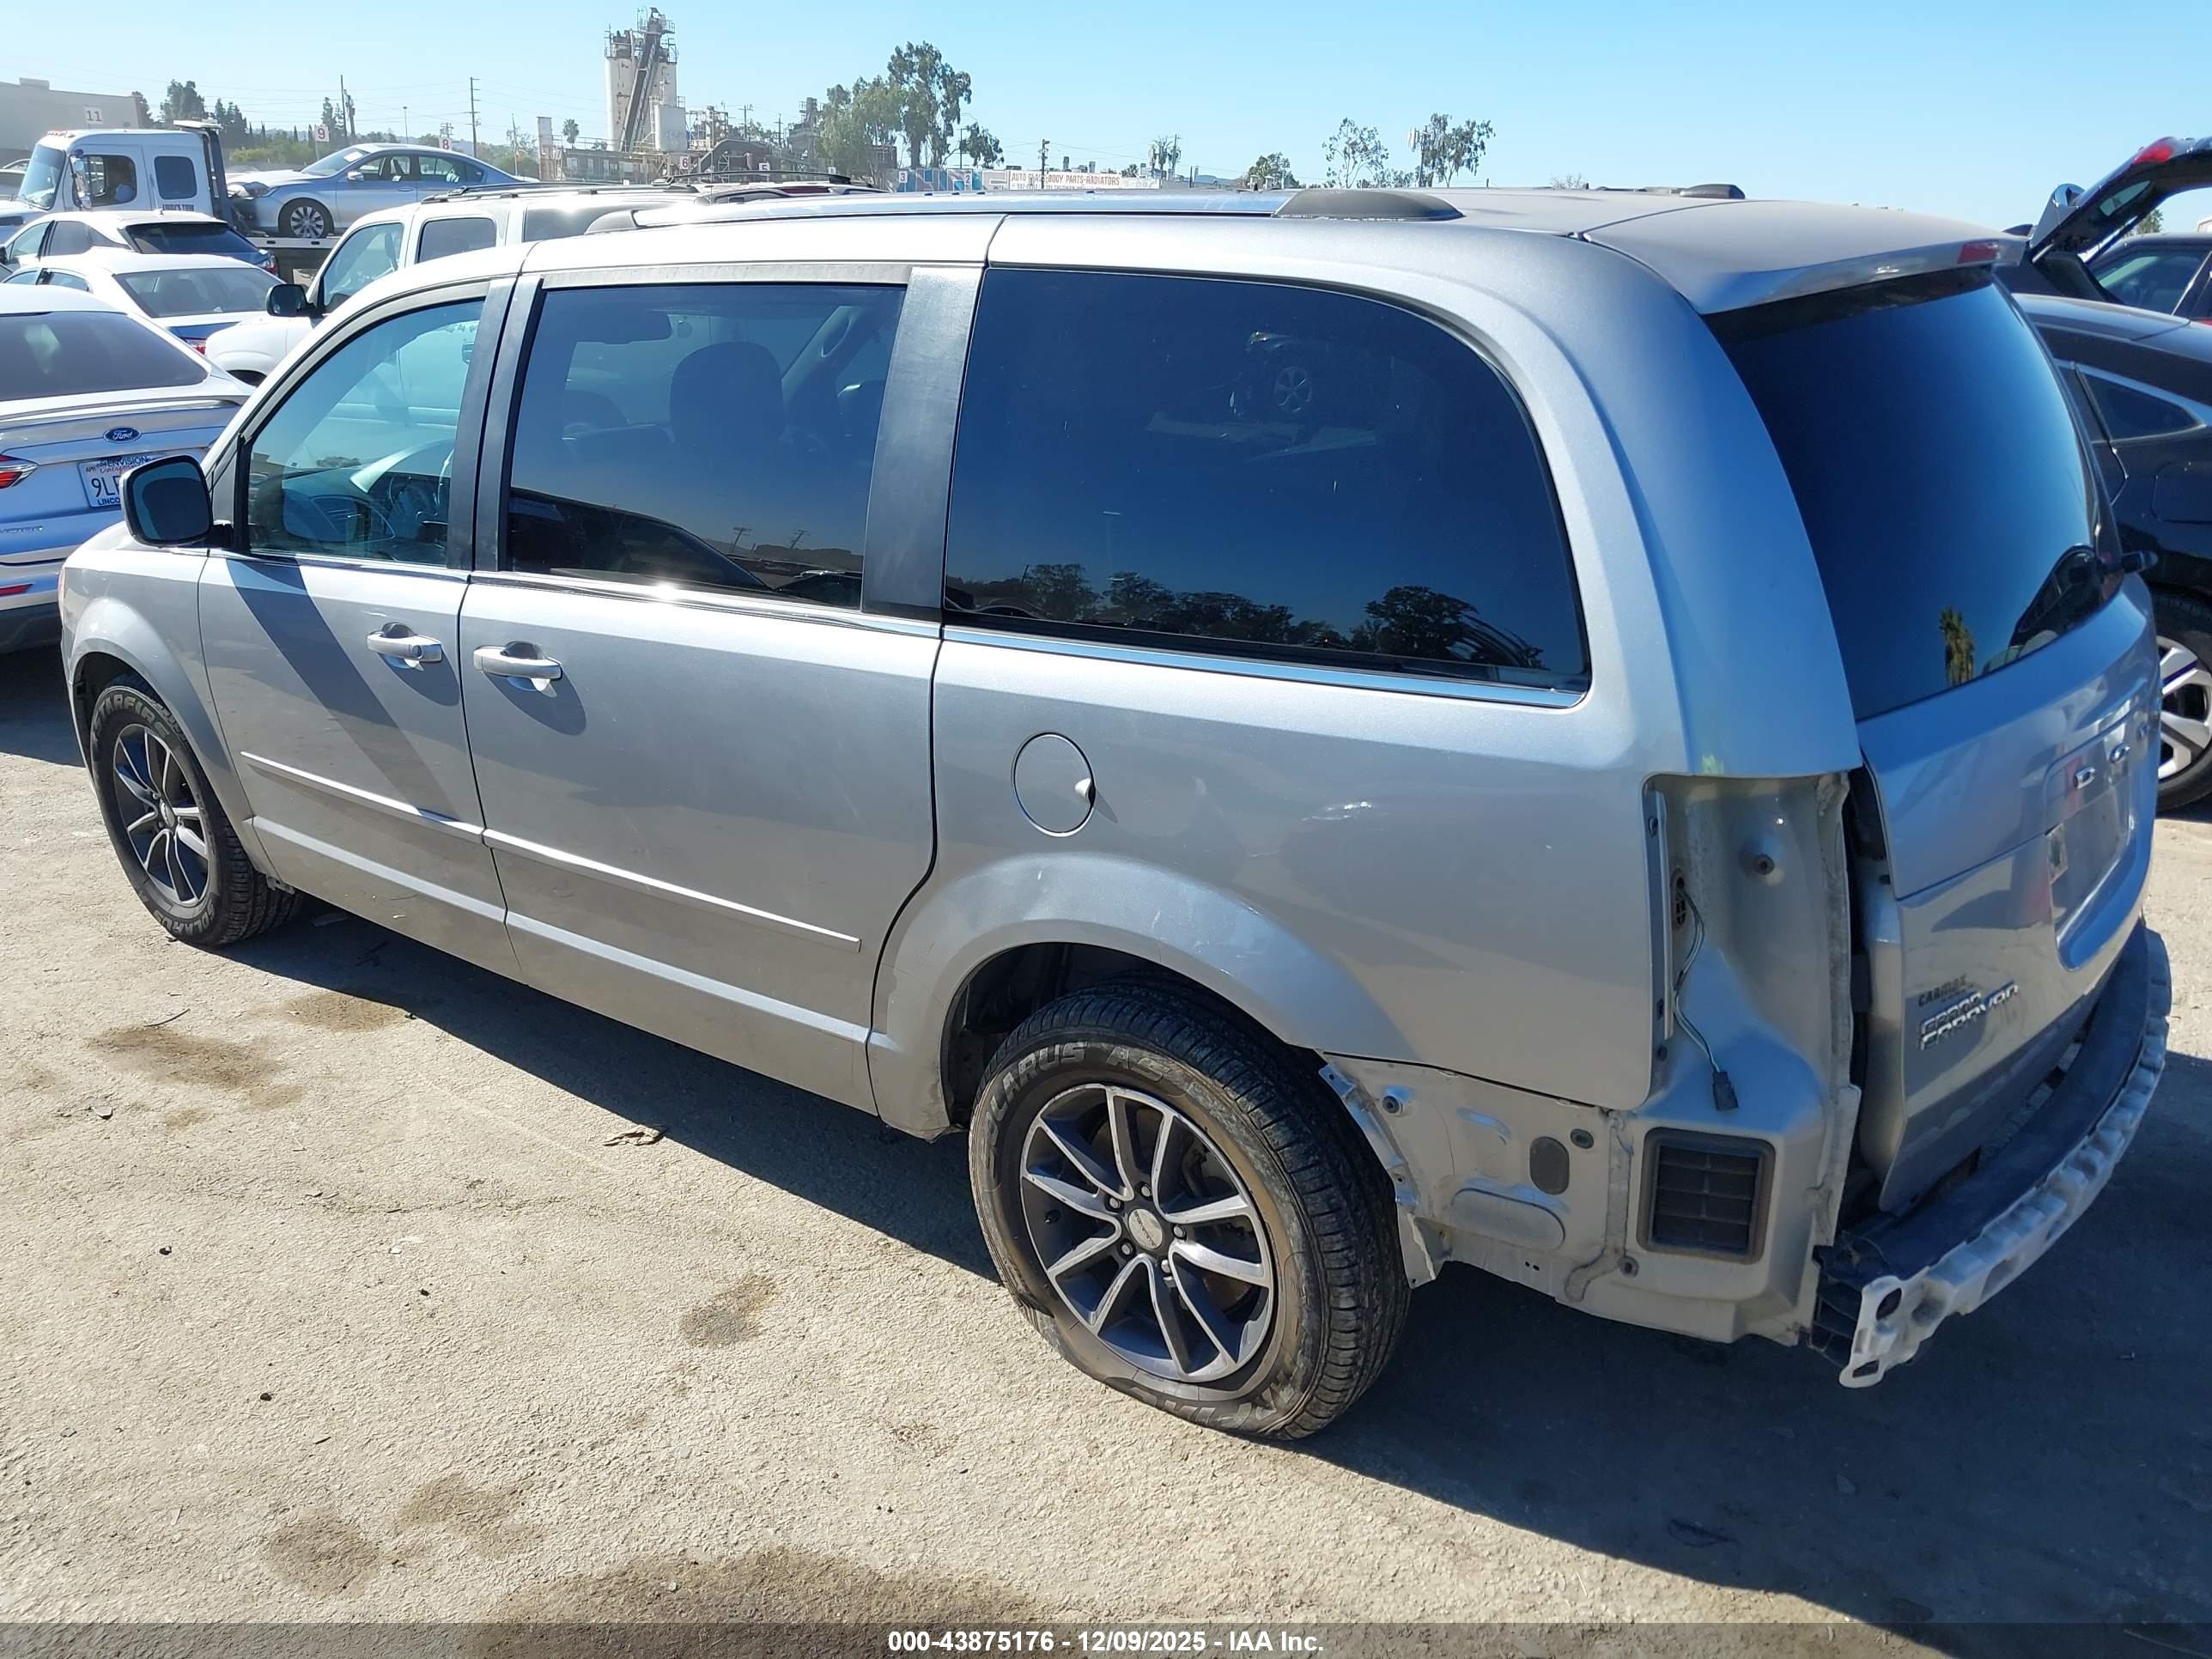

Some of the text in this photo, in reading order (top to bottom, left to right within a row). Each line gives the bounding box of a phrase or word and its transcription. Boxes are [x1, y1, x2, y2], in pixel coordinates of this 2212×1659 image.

[86, 110, 102, 122] 11
[318, 128, 325, 139] 9
[442, 138, 449, 149] 8
[682, 158, 689, 167] 6
[900, 173, 906, 181] 3
[965, 174, 970, 183] 2
[1012, 173, 1026, 181] AUTO
[112, 429, 133, 440] Ford
[107, 455, 148, 467] ENVISION
[94, 694, 170, 738] STARFIRE
[1106, 1046, 1170, 1082] AS
